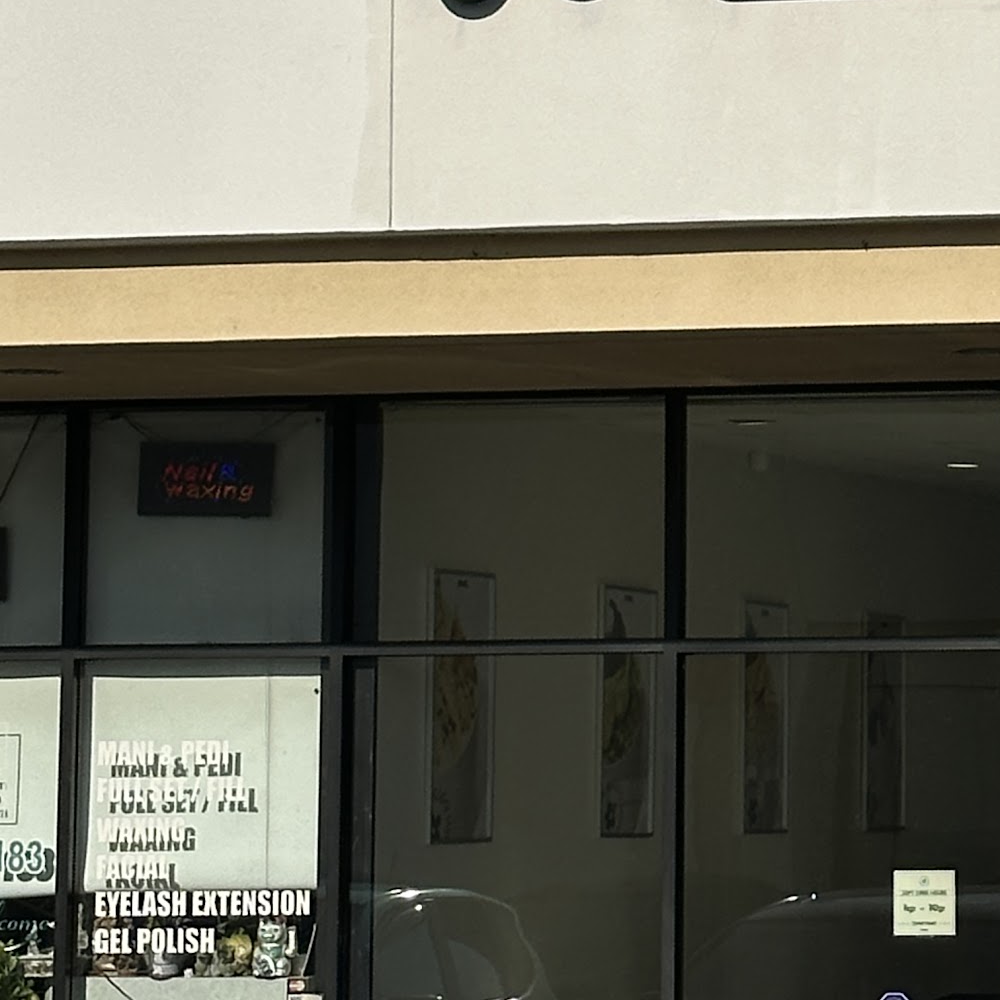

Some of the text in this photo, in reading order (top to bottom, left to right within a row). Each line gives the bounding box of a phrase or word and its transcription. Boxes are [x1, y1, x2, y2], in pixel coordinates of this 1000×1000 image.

[98, 740, 230, 766] MANI & PEDI
[97, 777, 144, 803] FULL
[149, 777, 188, 803] SET
[97, 817, 186, 843] WAXING
[95, 854, 170, 880] FACIAL
[95, 889, 311, 917] EYELASH EXTENSION
[93, 927, 216, 954] GEL POLISH
